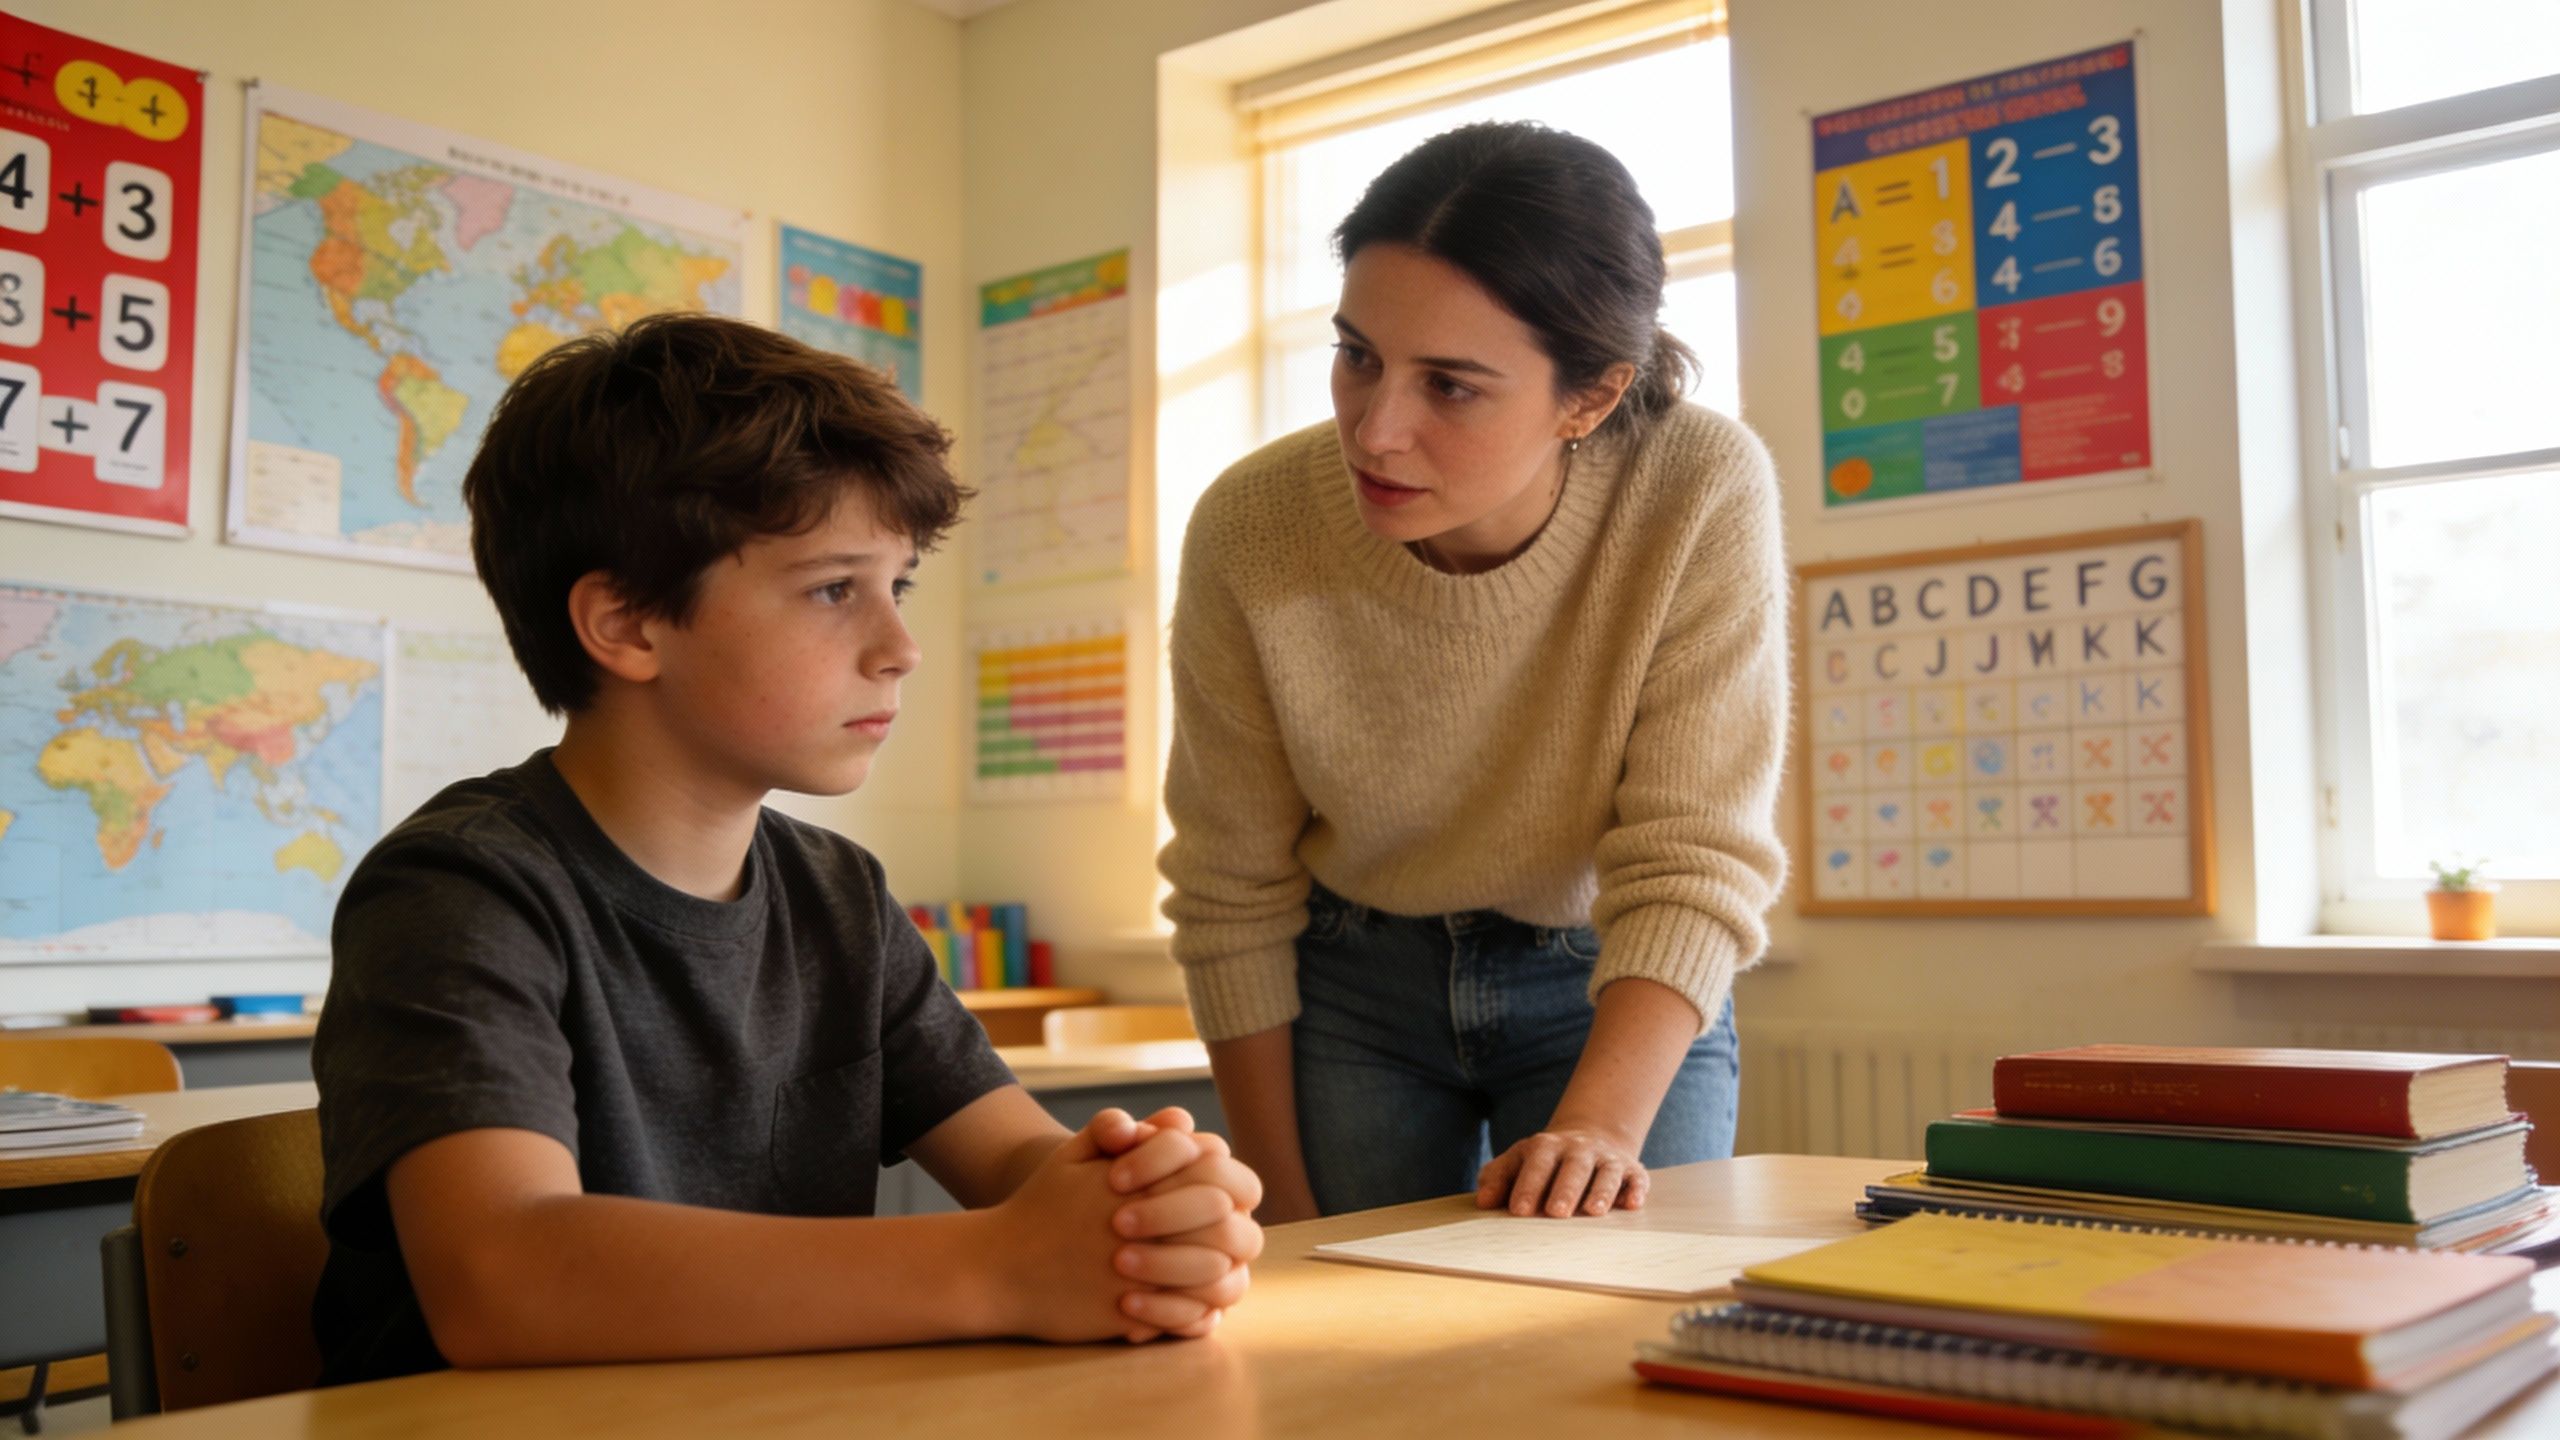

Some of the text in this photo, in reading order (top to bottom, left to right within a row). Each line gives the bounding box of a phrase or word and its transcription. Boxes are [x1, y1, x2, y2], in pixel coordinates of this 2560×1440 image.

[1928, 155, 1950, 200] 1
[1986, 137, 2021, 189] 2
[2087, 115, 2123, 165] 3
[0, 153, 34, 210] 4
[117, 181, 156, 241] 3
[1988, 200, 2022, 242] 4
[1930, 265, 1959, 305] 6
[1991, 255, 2022, 294] 4
[2093, 236, 2123, 277] 6
[114, 293, 155, 353] 5
[2096, 297, 2126, 338] 9
[1933, 324, 1960, 363] 5
[0, 377, 26, 431] 7
[113, 397, 153, 453] 7
[1937, 373, 1960, 407] 7
[1821, 553, 2168, 632] A B C D E F G
[1875, 643, 1899, 680] C
[1924, 638, 1947, 677] J
[1974, 634, 1999, 673] J
[2082, 624, 2111, 662] K
[2136, 618, 2166, 657] K
[2136, 675, 2163, 712] K
